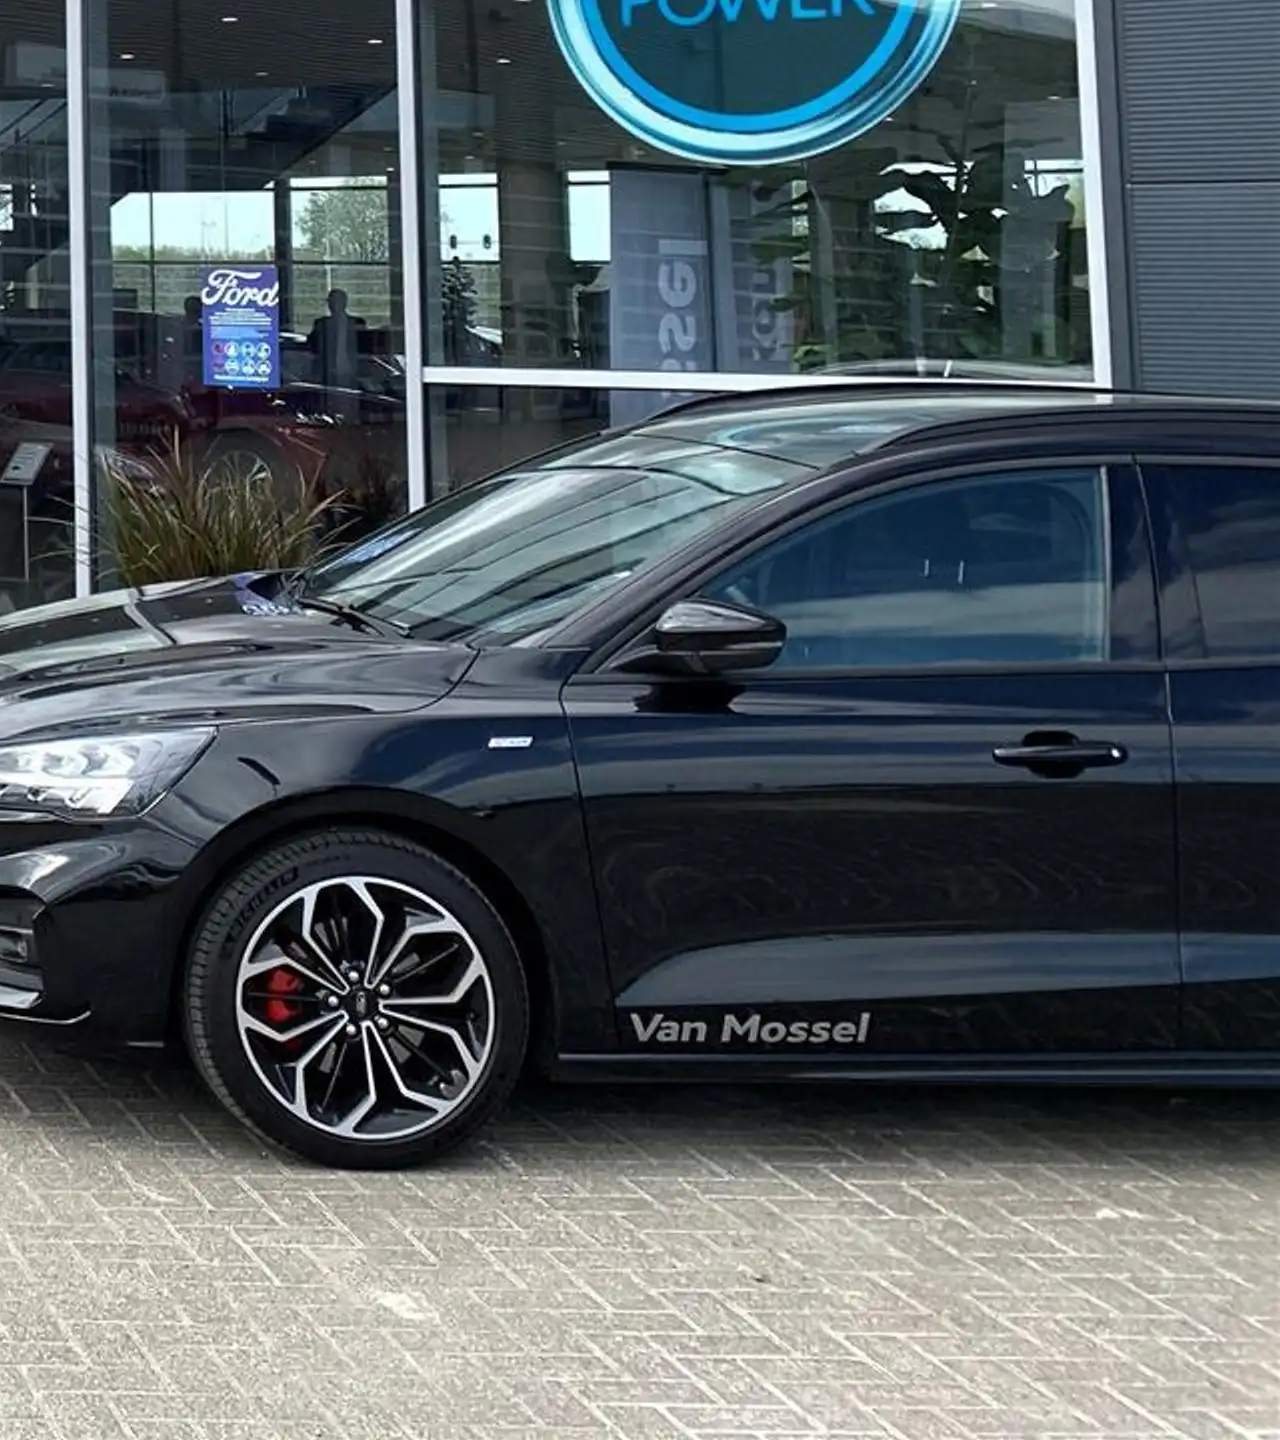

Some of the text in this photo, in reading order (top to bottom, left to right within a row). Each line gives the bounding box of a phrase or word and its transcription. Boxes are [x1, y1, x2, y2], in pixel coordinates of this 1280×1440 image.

[201, 269, 280, 308] Ford
[630, 1012, 871, 1043] Van Mossel
